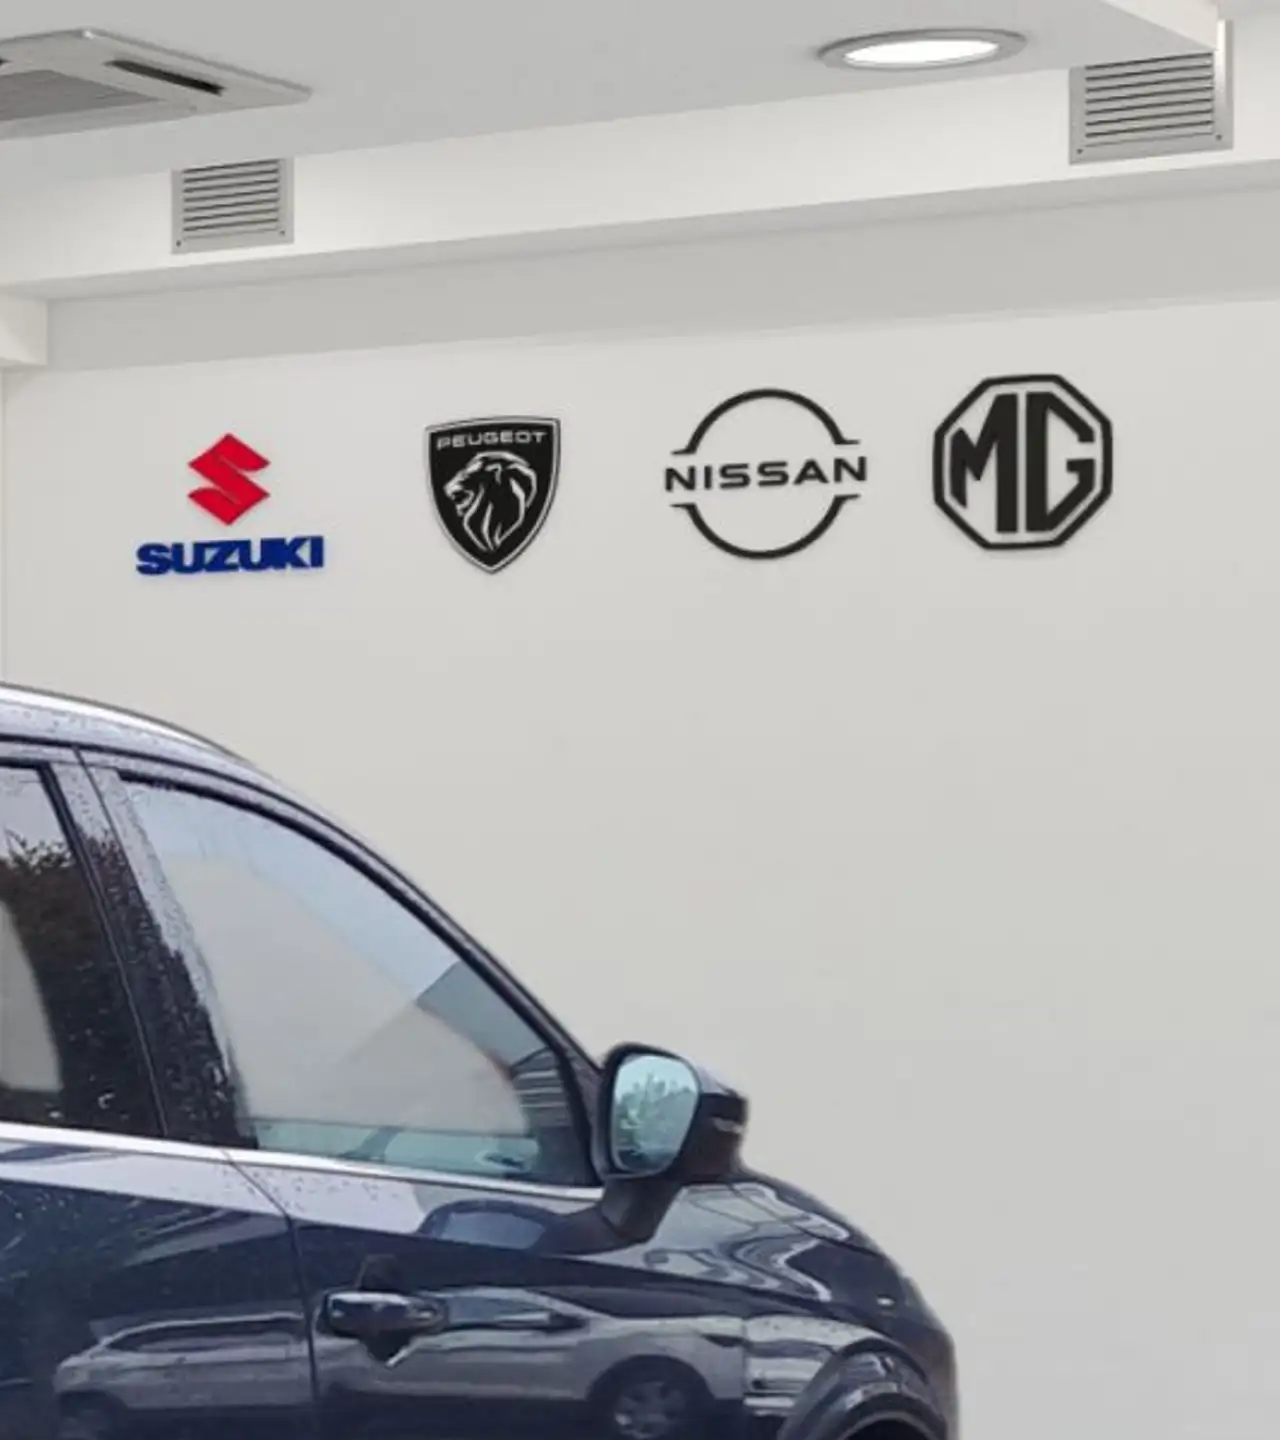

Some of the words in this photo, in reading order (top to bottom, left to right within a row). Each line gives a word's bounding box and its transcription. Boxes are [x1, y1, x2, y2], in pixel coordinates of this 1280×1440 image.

[436, 430, 547, 450] PEUGEOT
[665, 456, 866, 492] NISSAN
[950, 391, 1095, 533] MG
[136, 535, 324, 576] SUZUKI
